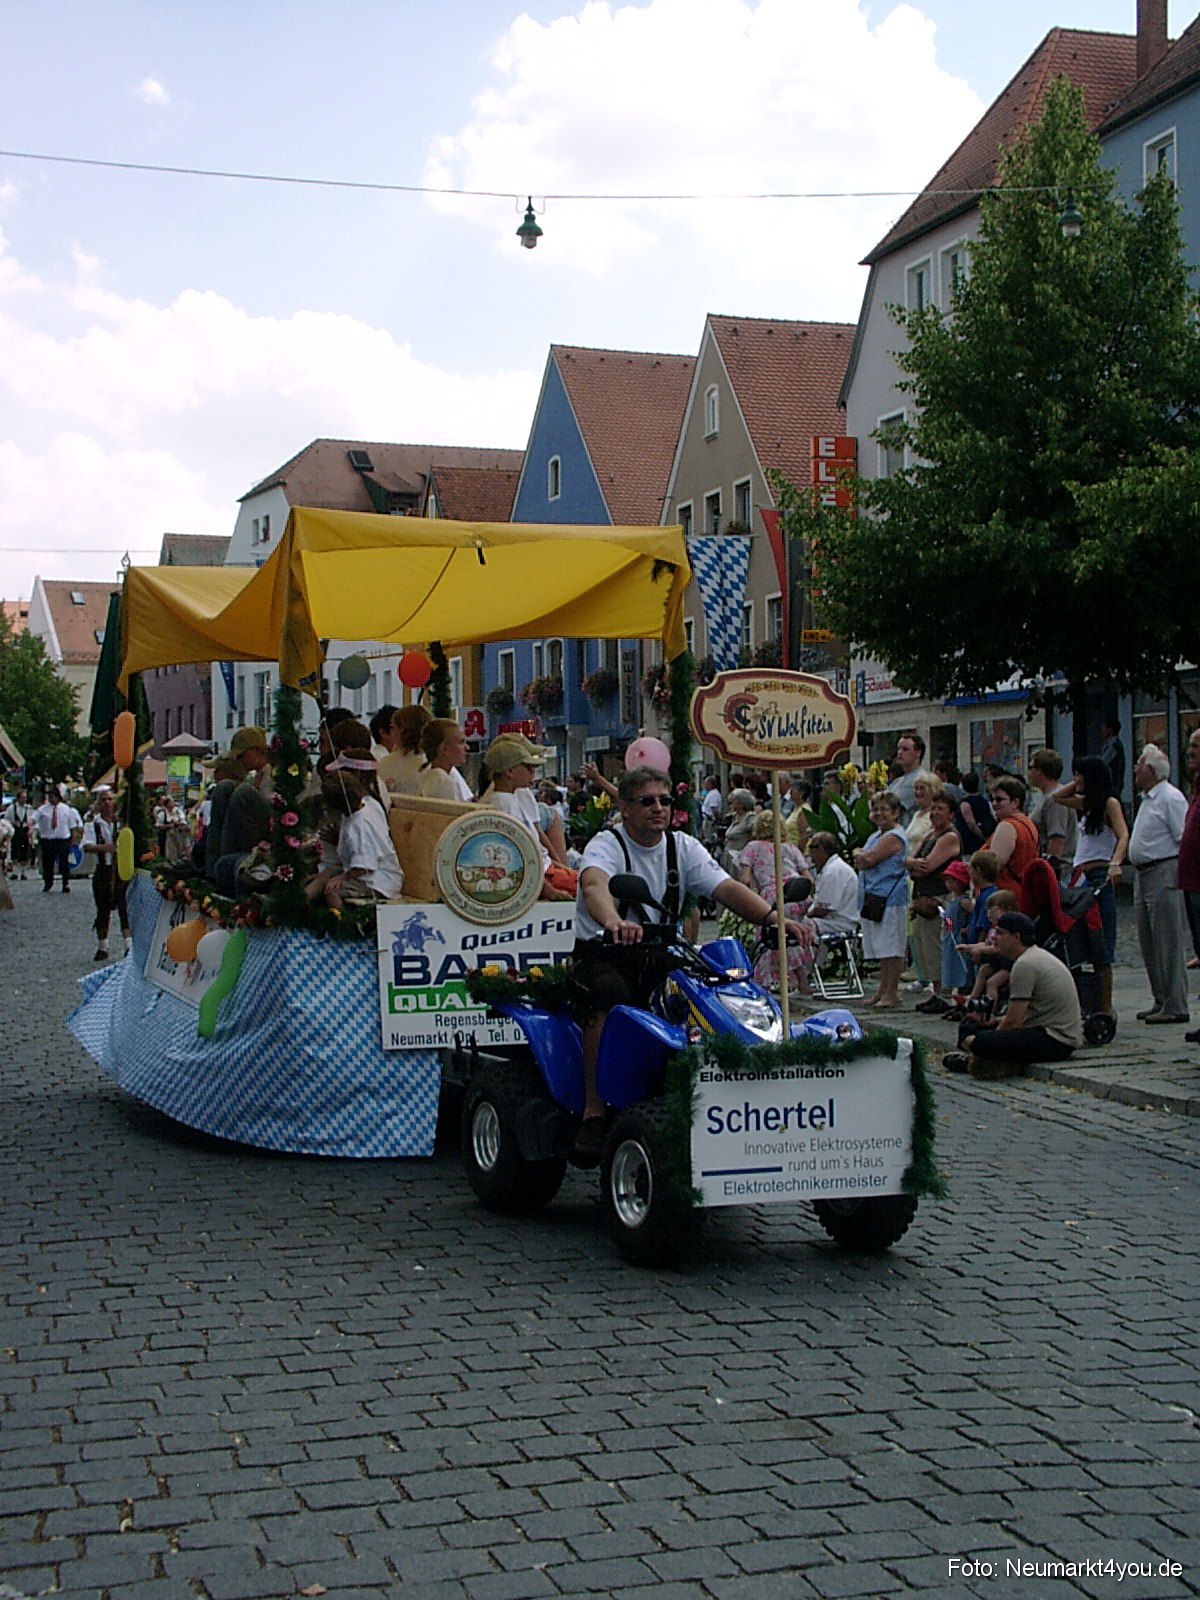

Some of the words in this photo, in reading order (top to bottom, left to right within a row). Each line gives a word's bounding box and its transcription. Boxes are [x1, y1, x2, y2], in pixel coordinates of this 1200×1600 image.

[818, 436, 836, 506] ELE
[777, 704, 834, 739] Wolfstein
[461, 923, 533, 951] Quad
[540, 918, 574, 936] Fu
[393, 951, 573, 987] BADE
[488, 1029, 509, 1043] Tel.
[513, 1028, 528, 1041] 0
[699, 1067, 846, 1083] Elektroinstallation
[706, 1098, 835, 1135] Schertel
[744, 1141, 806, 1156] Innovative
[810, 1137, 903, 1153] Elektrosysteme
[788, 1157, 817, 1172] rund
[853, 1154, 884, 1168] Haus
[723, 1174, 888, 1196] Elektrotechnikermeister
